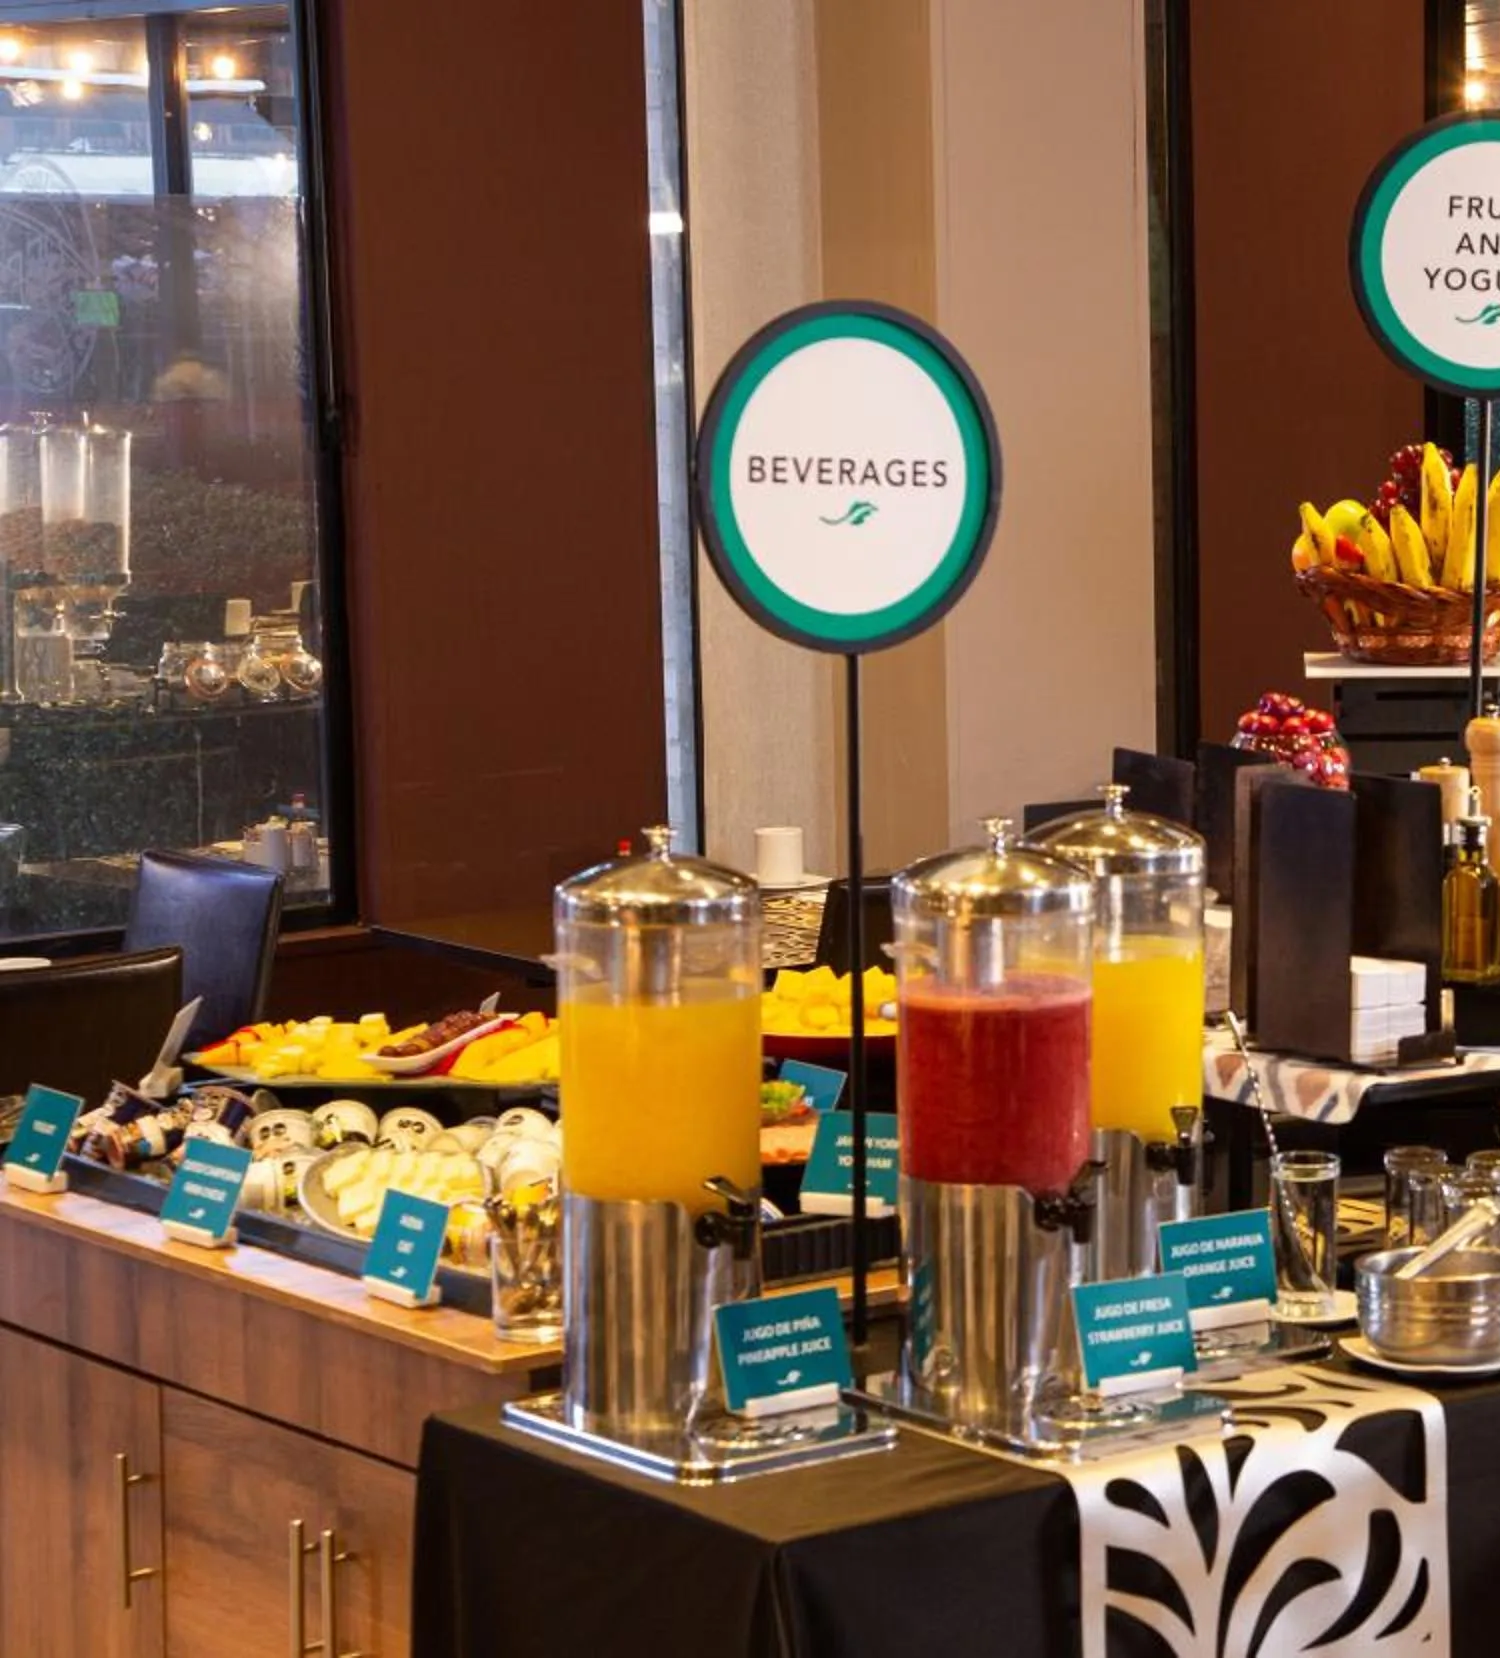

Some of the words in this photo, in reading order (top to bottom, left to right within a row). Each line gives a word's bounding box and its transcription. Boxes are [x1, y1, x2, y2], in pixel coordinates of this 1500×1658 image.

[748, 455, 948, 488] BEVERAGES
[1170, 1241, 1199, 1259] JUGO
[1199, 1239, 1215, 1254] DE
[1215, 1232, 1264, 1251] NARANJA
[1183, 1259, 1227, 1278] ORANGE
[1229, 1254, 1256, 1271] JUICE
[1094, 1302, 1123, 1320] JUGO
[1123, 1300, 1139, 1316] DE
[1139, 1296, 1173, 1313] FRESA
[742, 1323, 775, 1343] JUGO
[775, 1319, 792, 1337] DE
[792, 1315, 822, 1333] PIÑA
[1087, 1321, 1155, 1345] STRAWBERRY
[1156, 1317, 1186, 1335] JUICE
[737, 1341, 800, 1366] PINEAPPLE
[800, 1335, 832, 1356] JUICE
